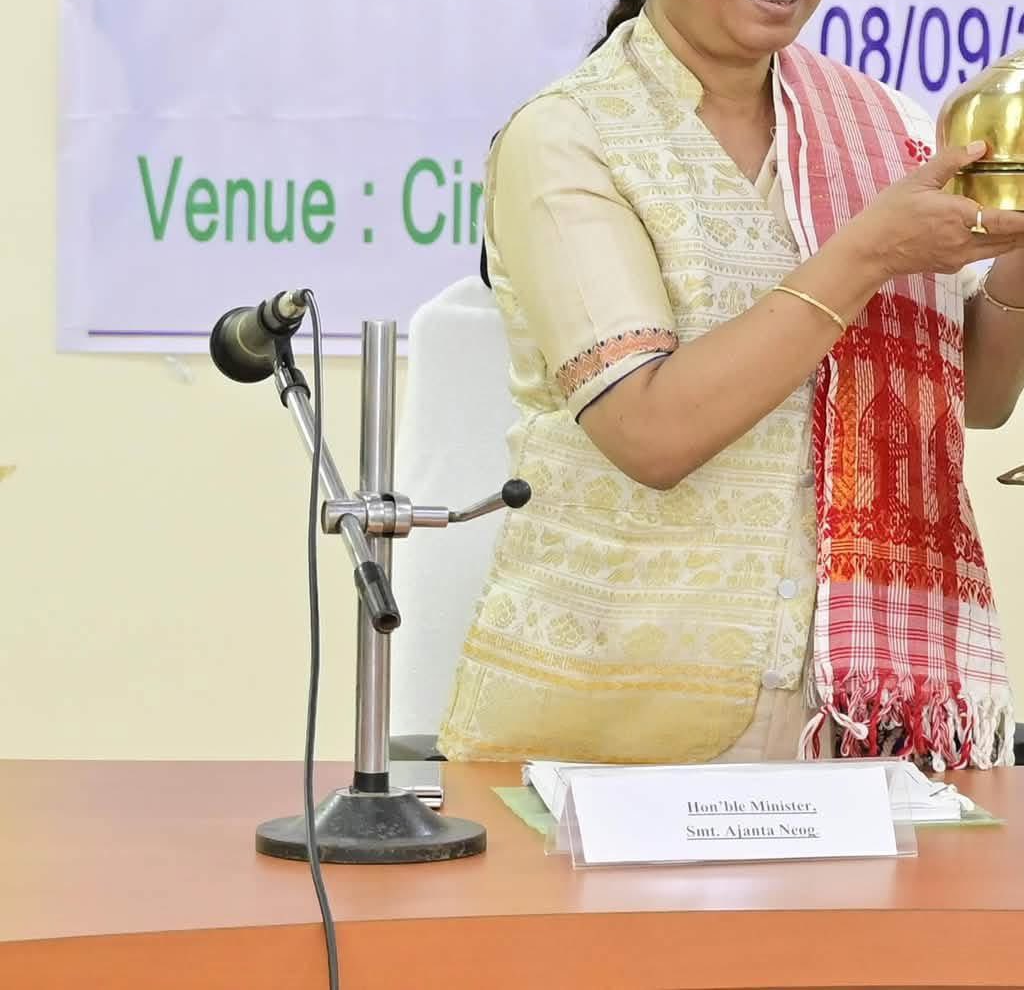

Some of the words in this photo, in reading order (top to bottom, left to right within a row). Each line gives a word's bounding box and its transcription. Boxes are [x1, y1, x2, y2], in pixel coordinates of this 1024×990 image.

[137, 155, 335, 243] Venue
[362, 181, 374, 244] :
[403, 158, 485, 245] Cir
[688, 800, 746, 814] Hon’ble
[686, 825, 721, 839] Smt.
[726, 824, 775, 839] Ajanta
